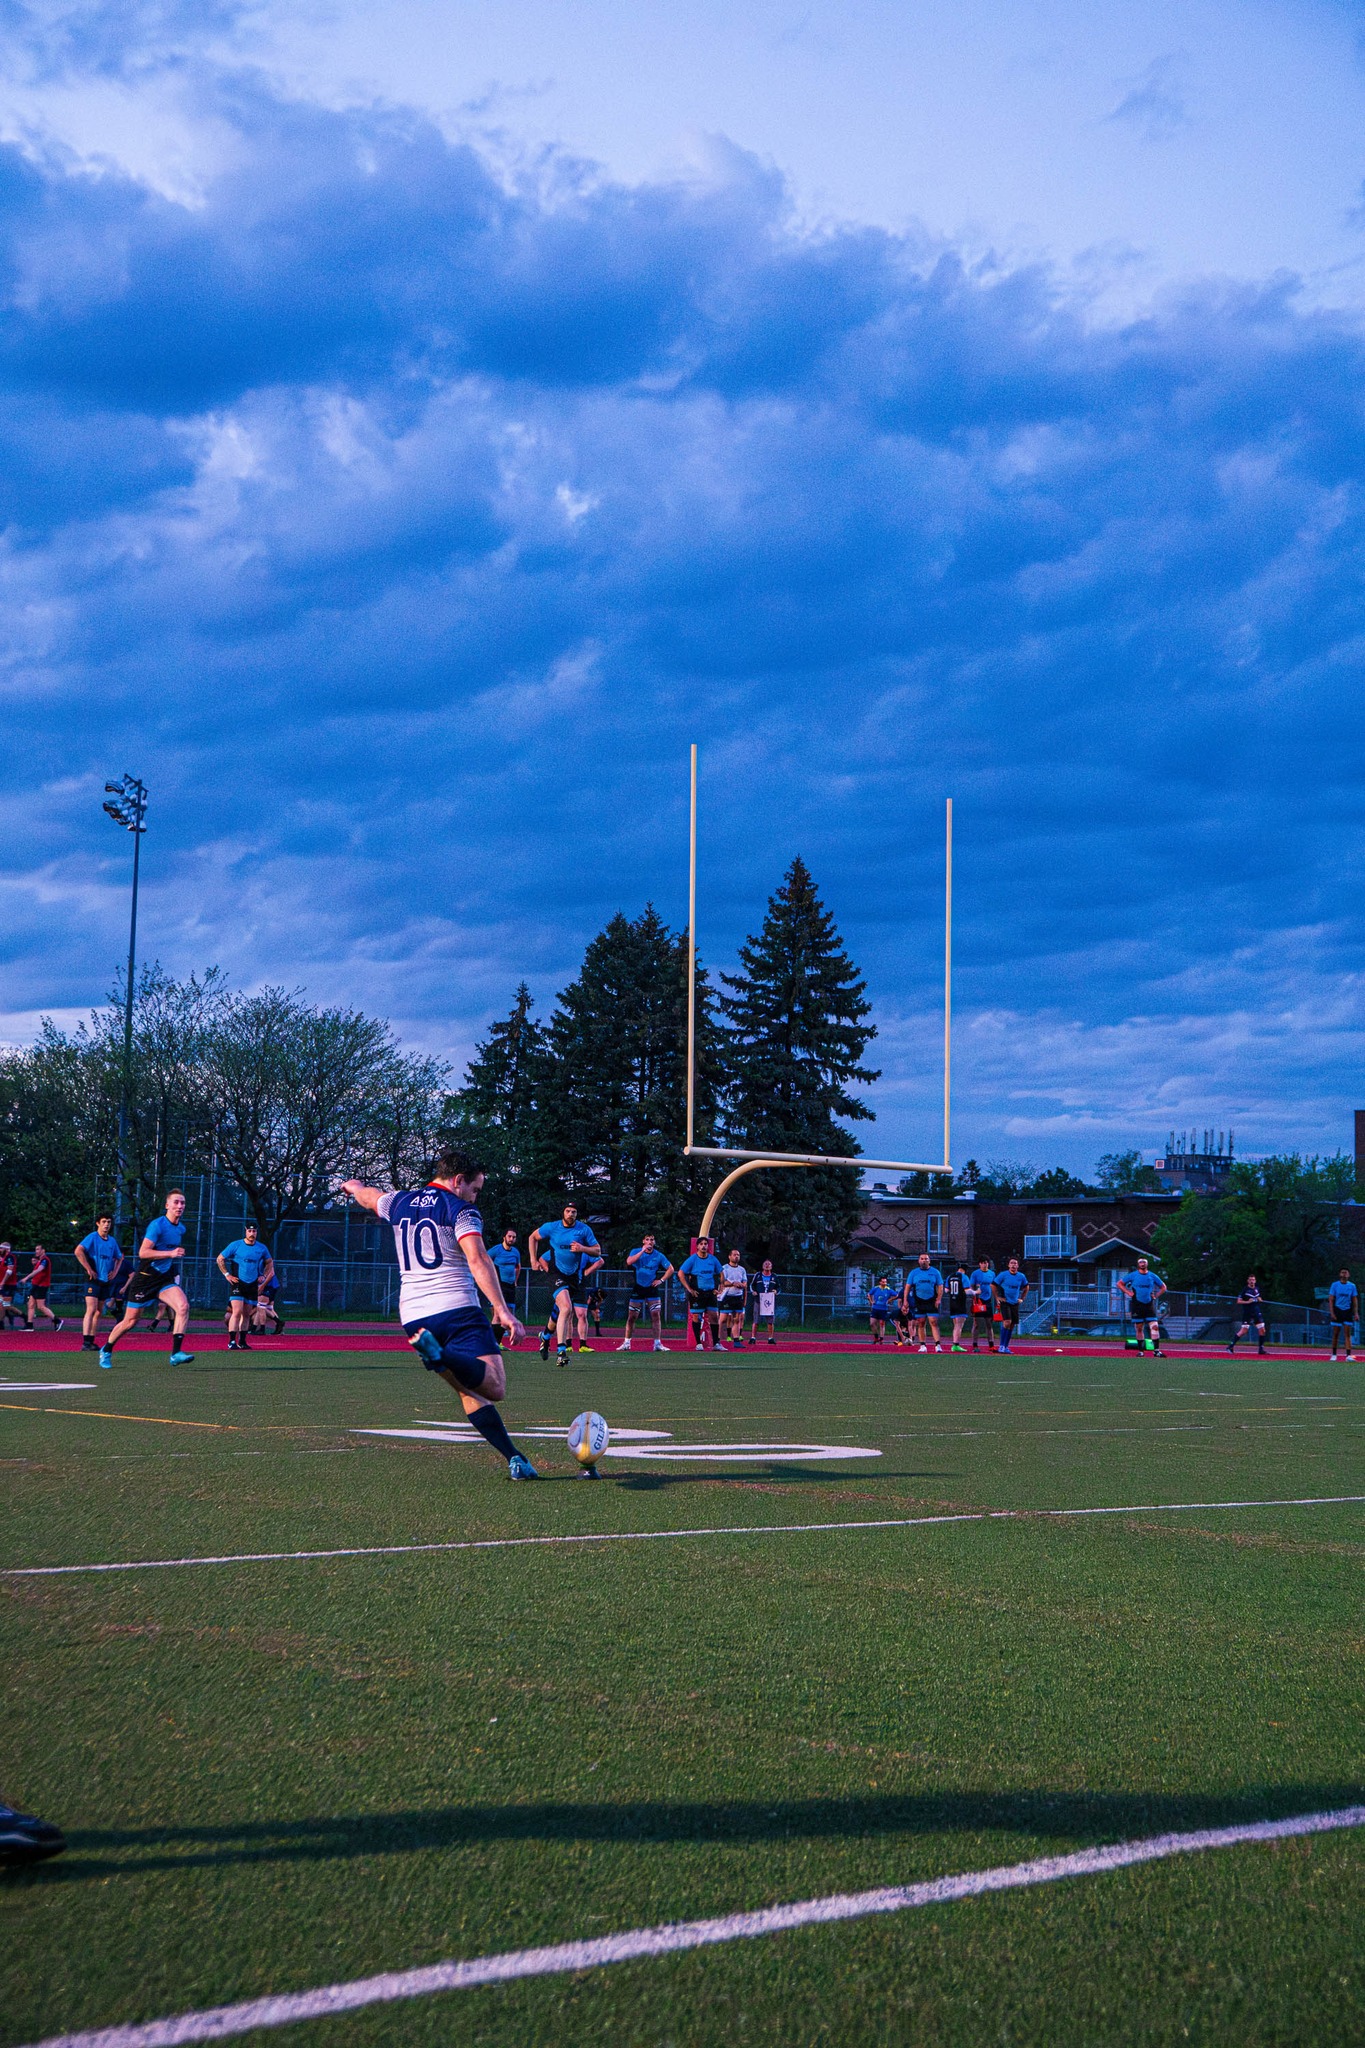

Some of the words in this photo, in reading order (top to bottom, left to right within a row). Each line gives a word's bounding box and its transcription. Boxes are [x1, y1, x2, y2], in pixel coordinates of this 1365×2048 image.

[409, 1195, 439, 1207] ASN
[399, 1218, 443, 1271] 10
[950, 1280, 959, 1295] 10
